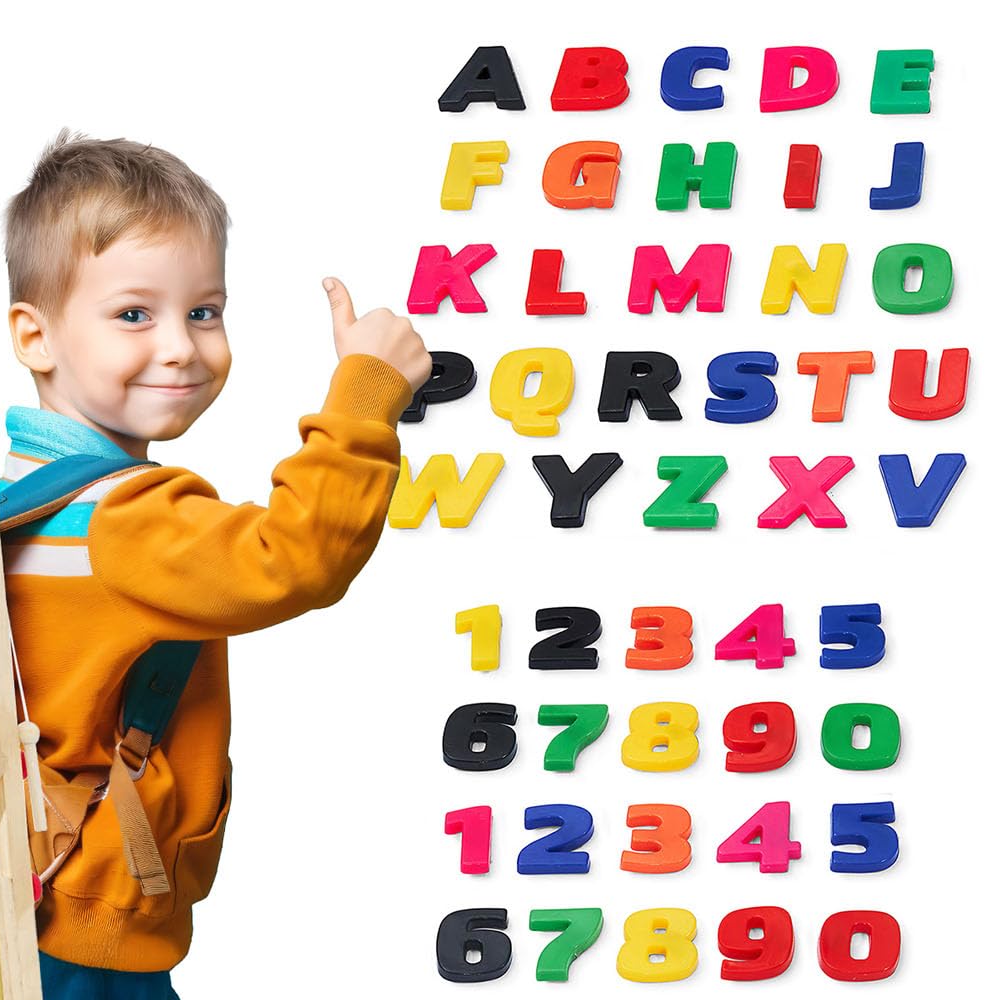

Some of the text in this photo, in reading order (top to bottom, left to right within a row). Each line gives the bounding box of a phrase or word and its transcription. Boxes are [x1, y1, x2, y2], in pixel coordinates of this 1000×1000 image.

[438, 46, 935, 114] A B C D E
[440, 141, 925, 210] F G H I J
[407, 243, 955, 315] K L M N O
[490, 348, 575, 437] Q
[598, 351, 683, 422] R
[705, 351, 779, 424] S
[797, 351, 875, 422] T
[889, 348, 970, 421] U
[388, 453, 967, 528] W Y Z X V
[455, 604, 886, 671] 1 2 3 4 5
[443, 702, 901, 773] 6 7 8 9 0
[444, 801, 900, 875] 1 2 3 4 5
[436, 906, 901, 983] 6 7 8 9 0
